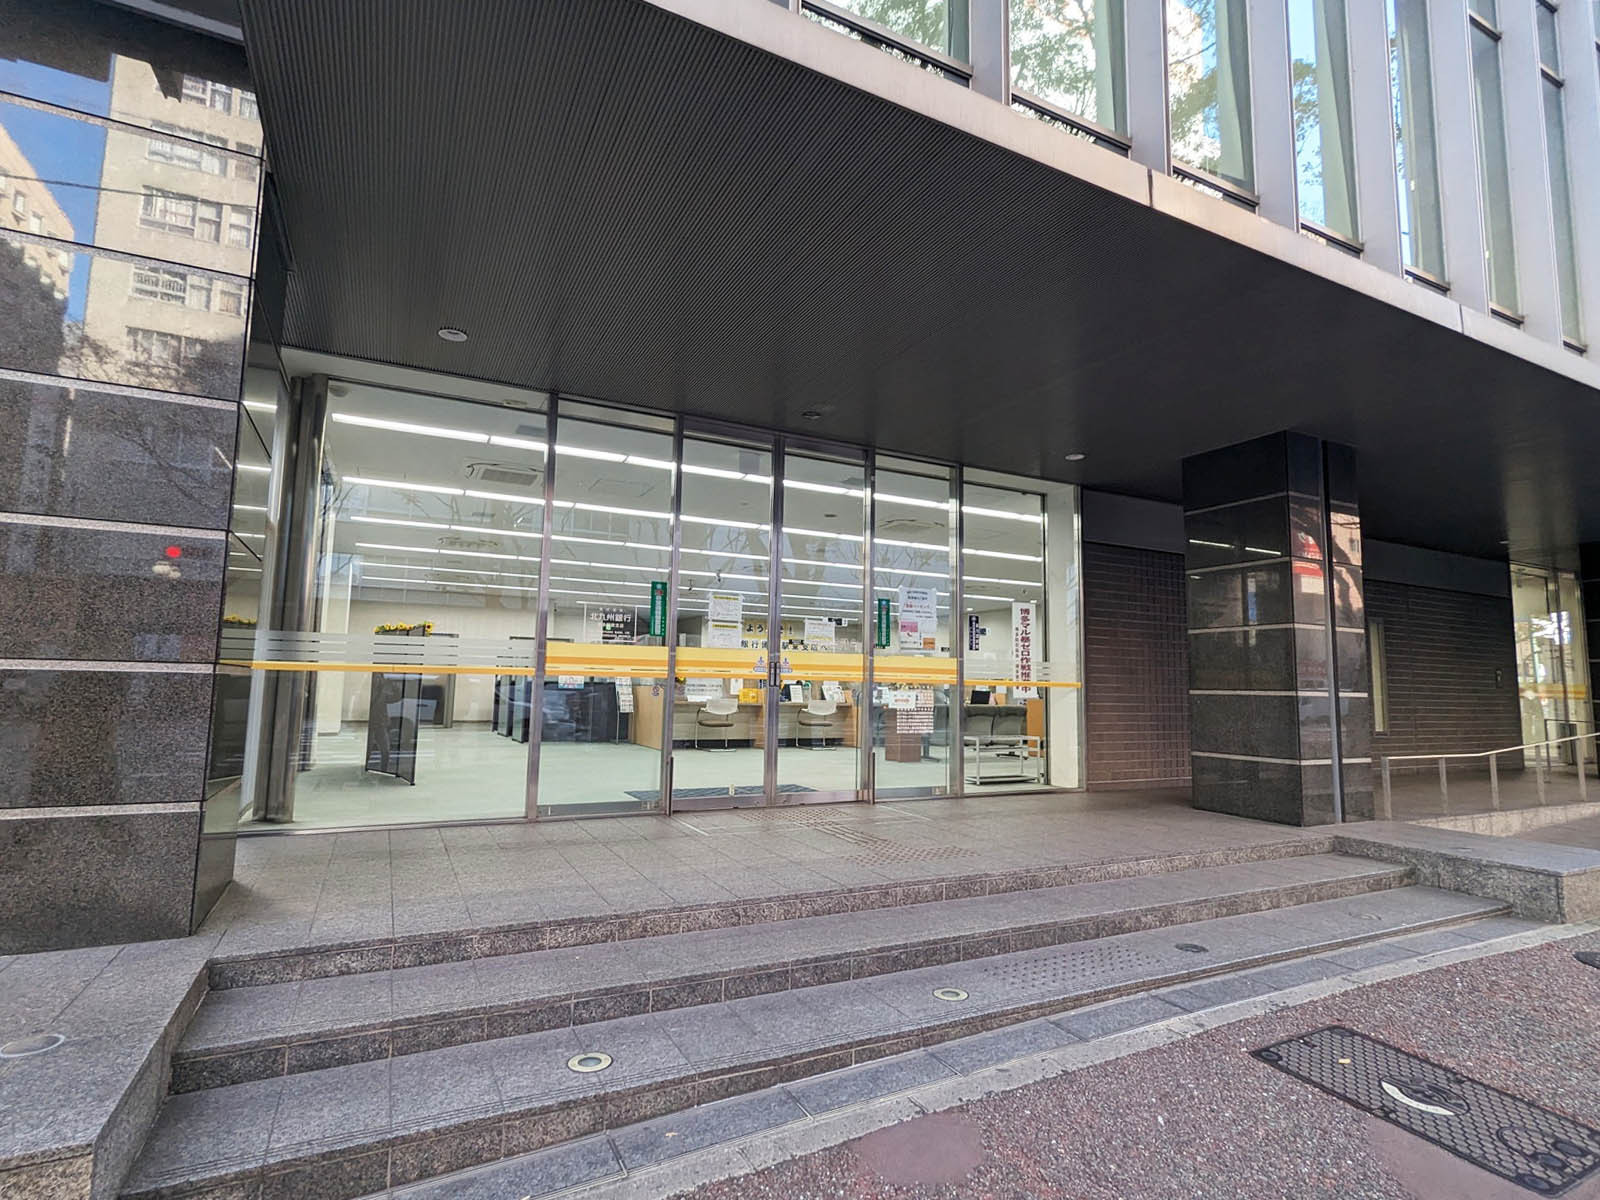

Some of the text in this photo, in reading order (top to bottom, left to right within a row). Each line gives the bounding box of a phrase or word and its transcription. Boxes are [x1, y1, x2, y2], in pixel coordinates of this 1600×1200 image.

[1019, 607, 1032, 694] 博多マル暴ゼロ作戦推中
